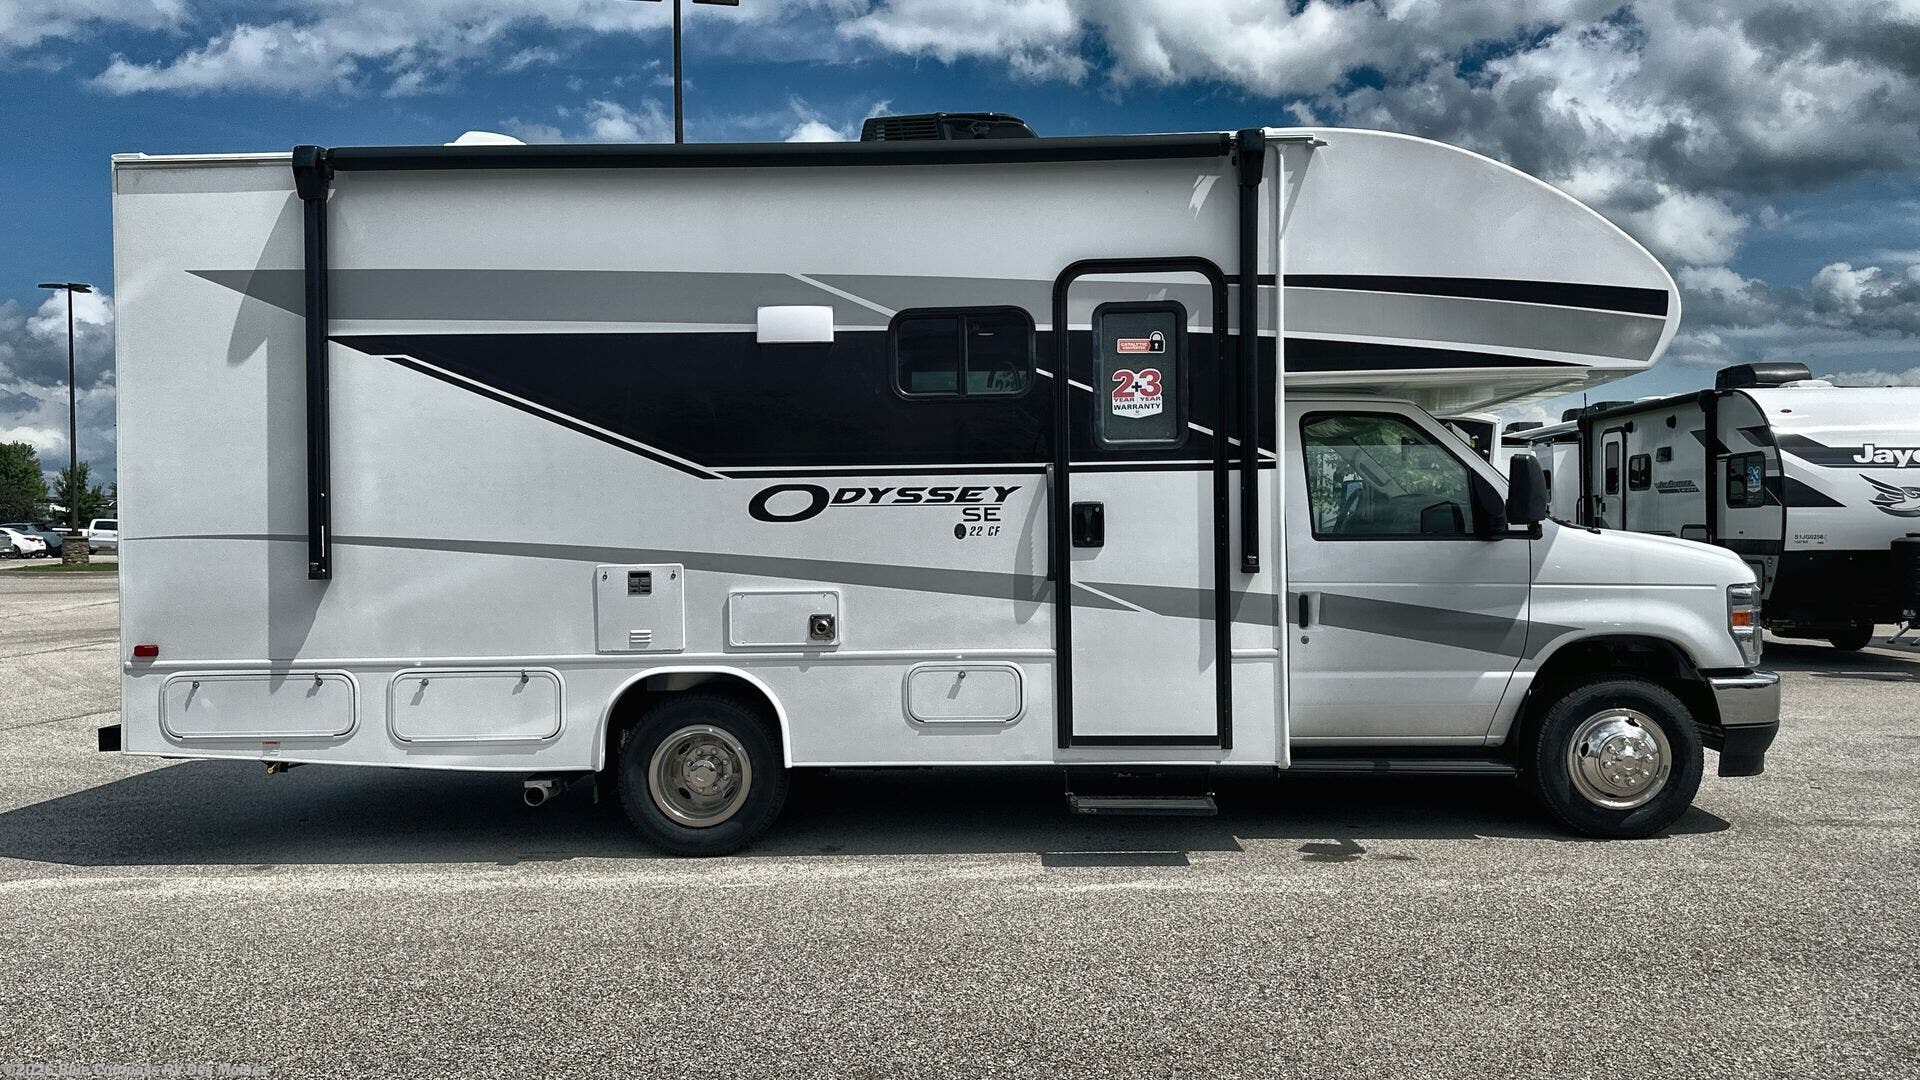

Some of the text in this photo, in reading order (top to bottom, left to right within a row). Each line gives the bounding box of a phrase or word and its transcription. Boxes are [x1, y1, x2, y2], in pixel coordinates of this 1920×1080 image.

[748, 484, 1023, 522] ODYSSEY
[962, 507, 1001, 521] SE
[969, 526, 1000, 536] 22 CF
